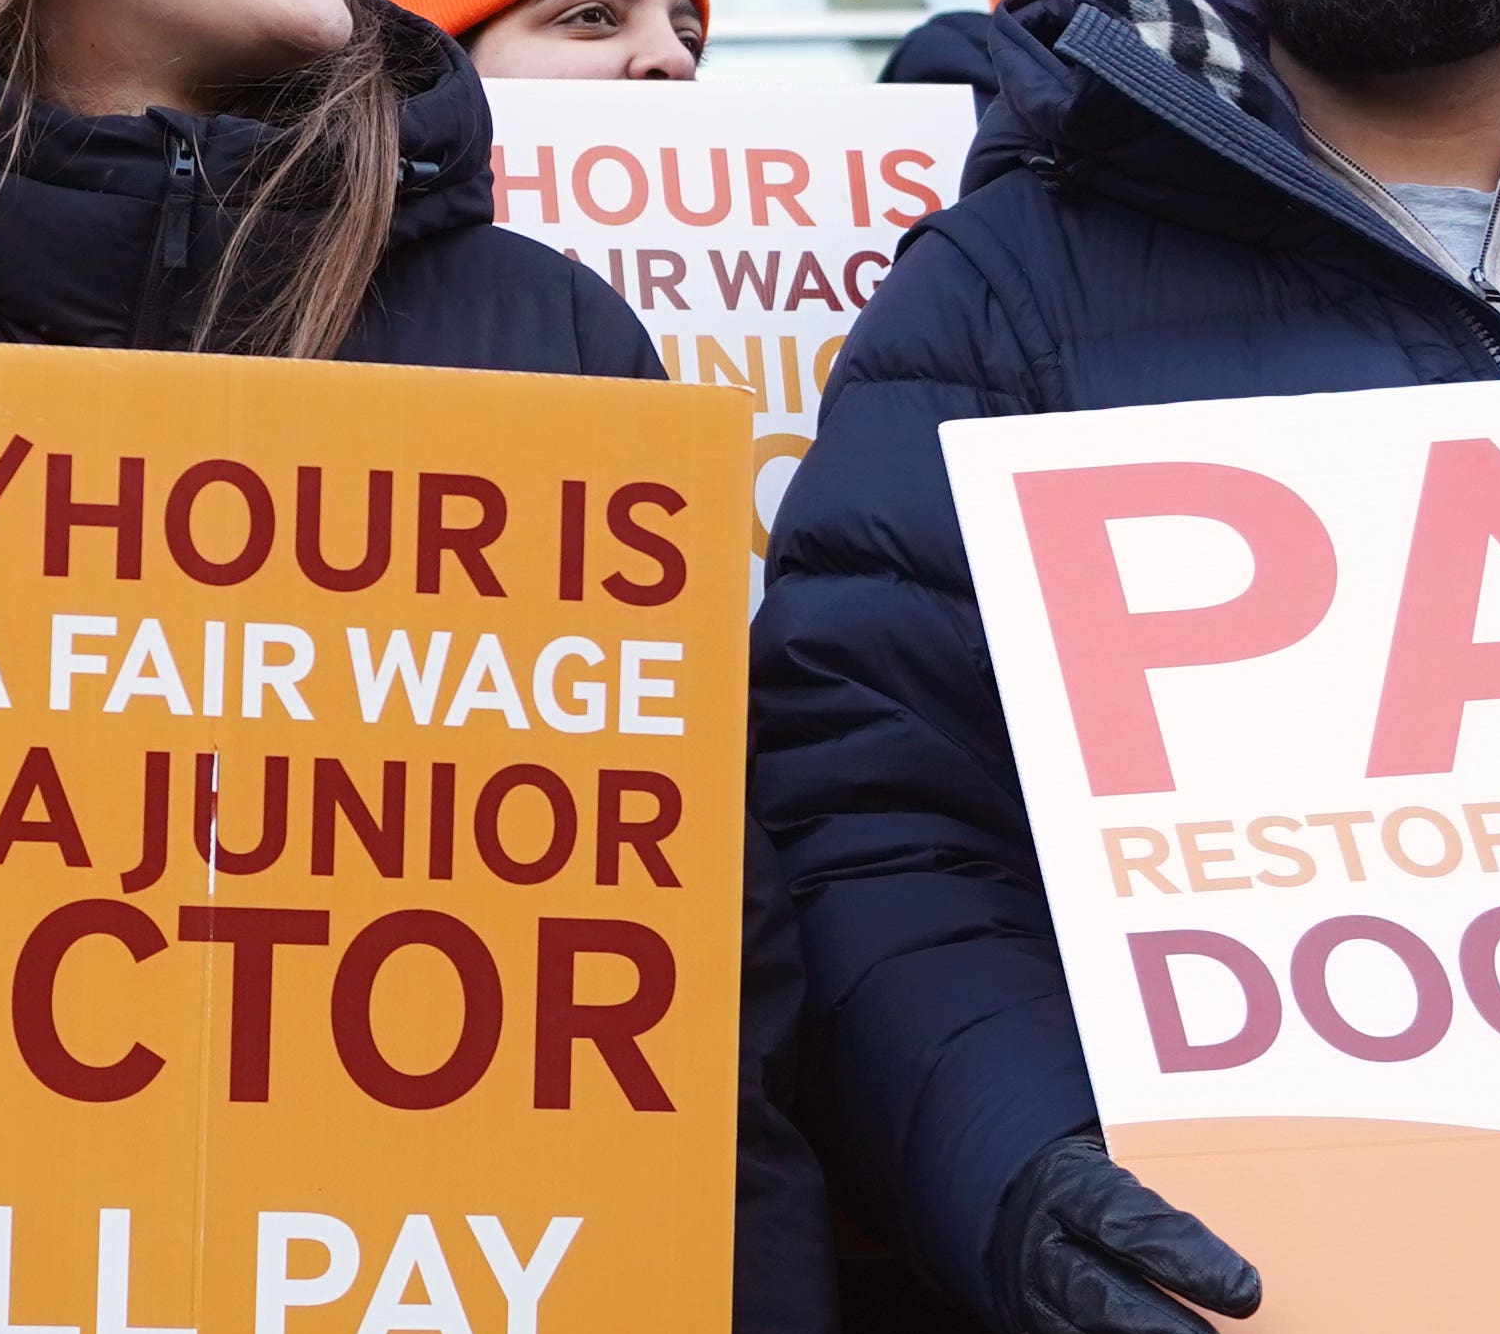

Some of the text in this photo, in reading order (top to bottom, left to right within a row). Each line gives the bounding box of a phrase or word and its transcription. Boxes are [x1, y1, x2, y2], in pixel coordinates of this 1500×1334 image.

[845, 149, 942, 228] IS
[559, 479, 688, 607] IS
[48, 613, 316, 720] FAIR
[346, 627, 684, 736] WAGE
[121, 751, 683, 893] JUNIOR
